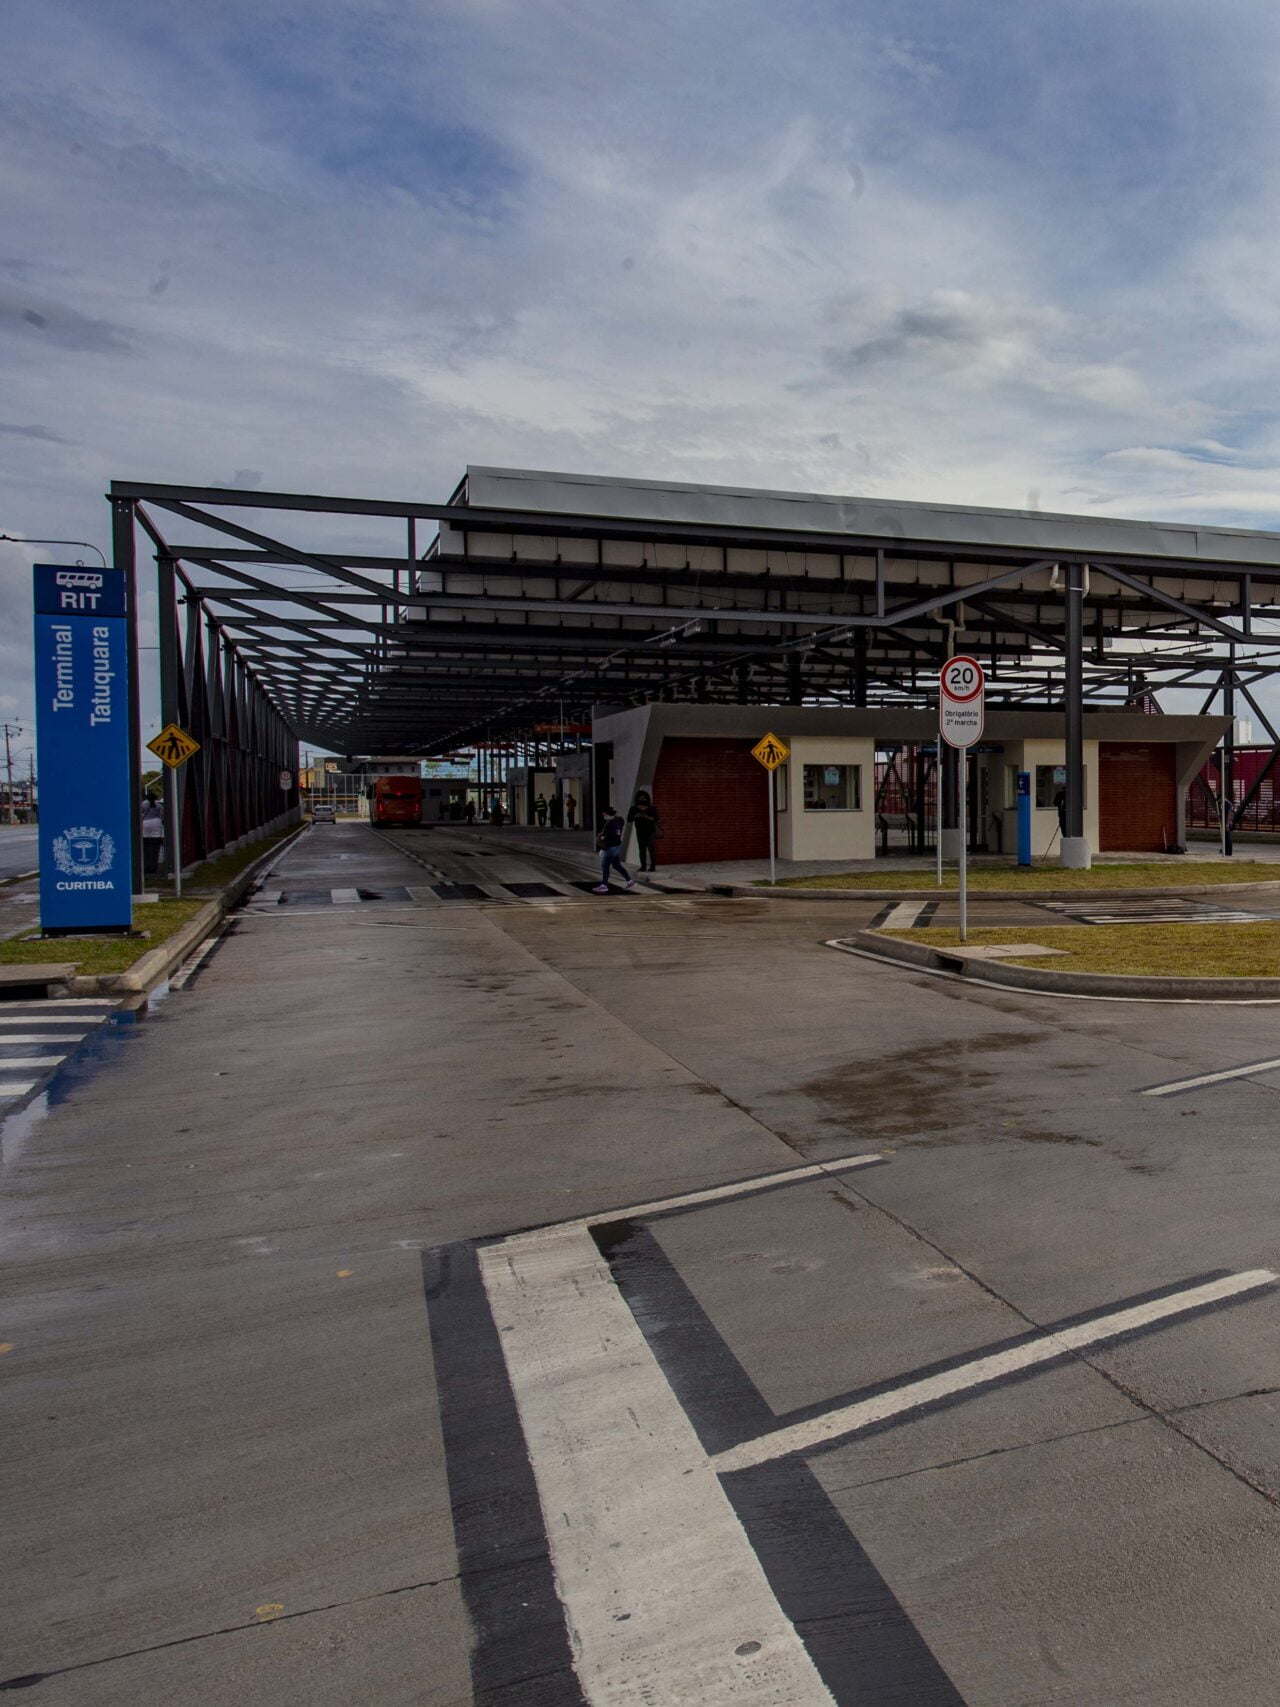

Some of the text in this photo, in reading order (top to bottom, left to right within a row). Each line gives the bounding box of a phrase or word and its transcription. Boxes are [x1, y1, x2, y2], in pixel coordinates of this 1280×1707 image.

[60, 592, 102, 609] RIT
[51, 624, 74, 712] Terminal
[950, 668, 974, 684] 20
[90, 626, 116, 727] Tatuquara
[944, 710, 979, 718] Obrigatório
[56, 881, 115, 891] CURITIBA
